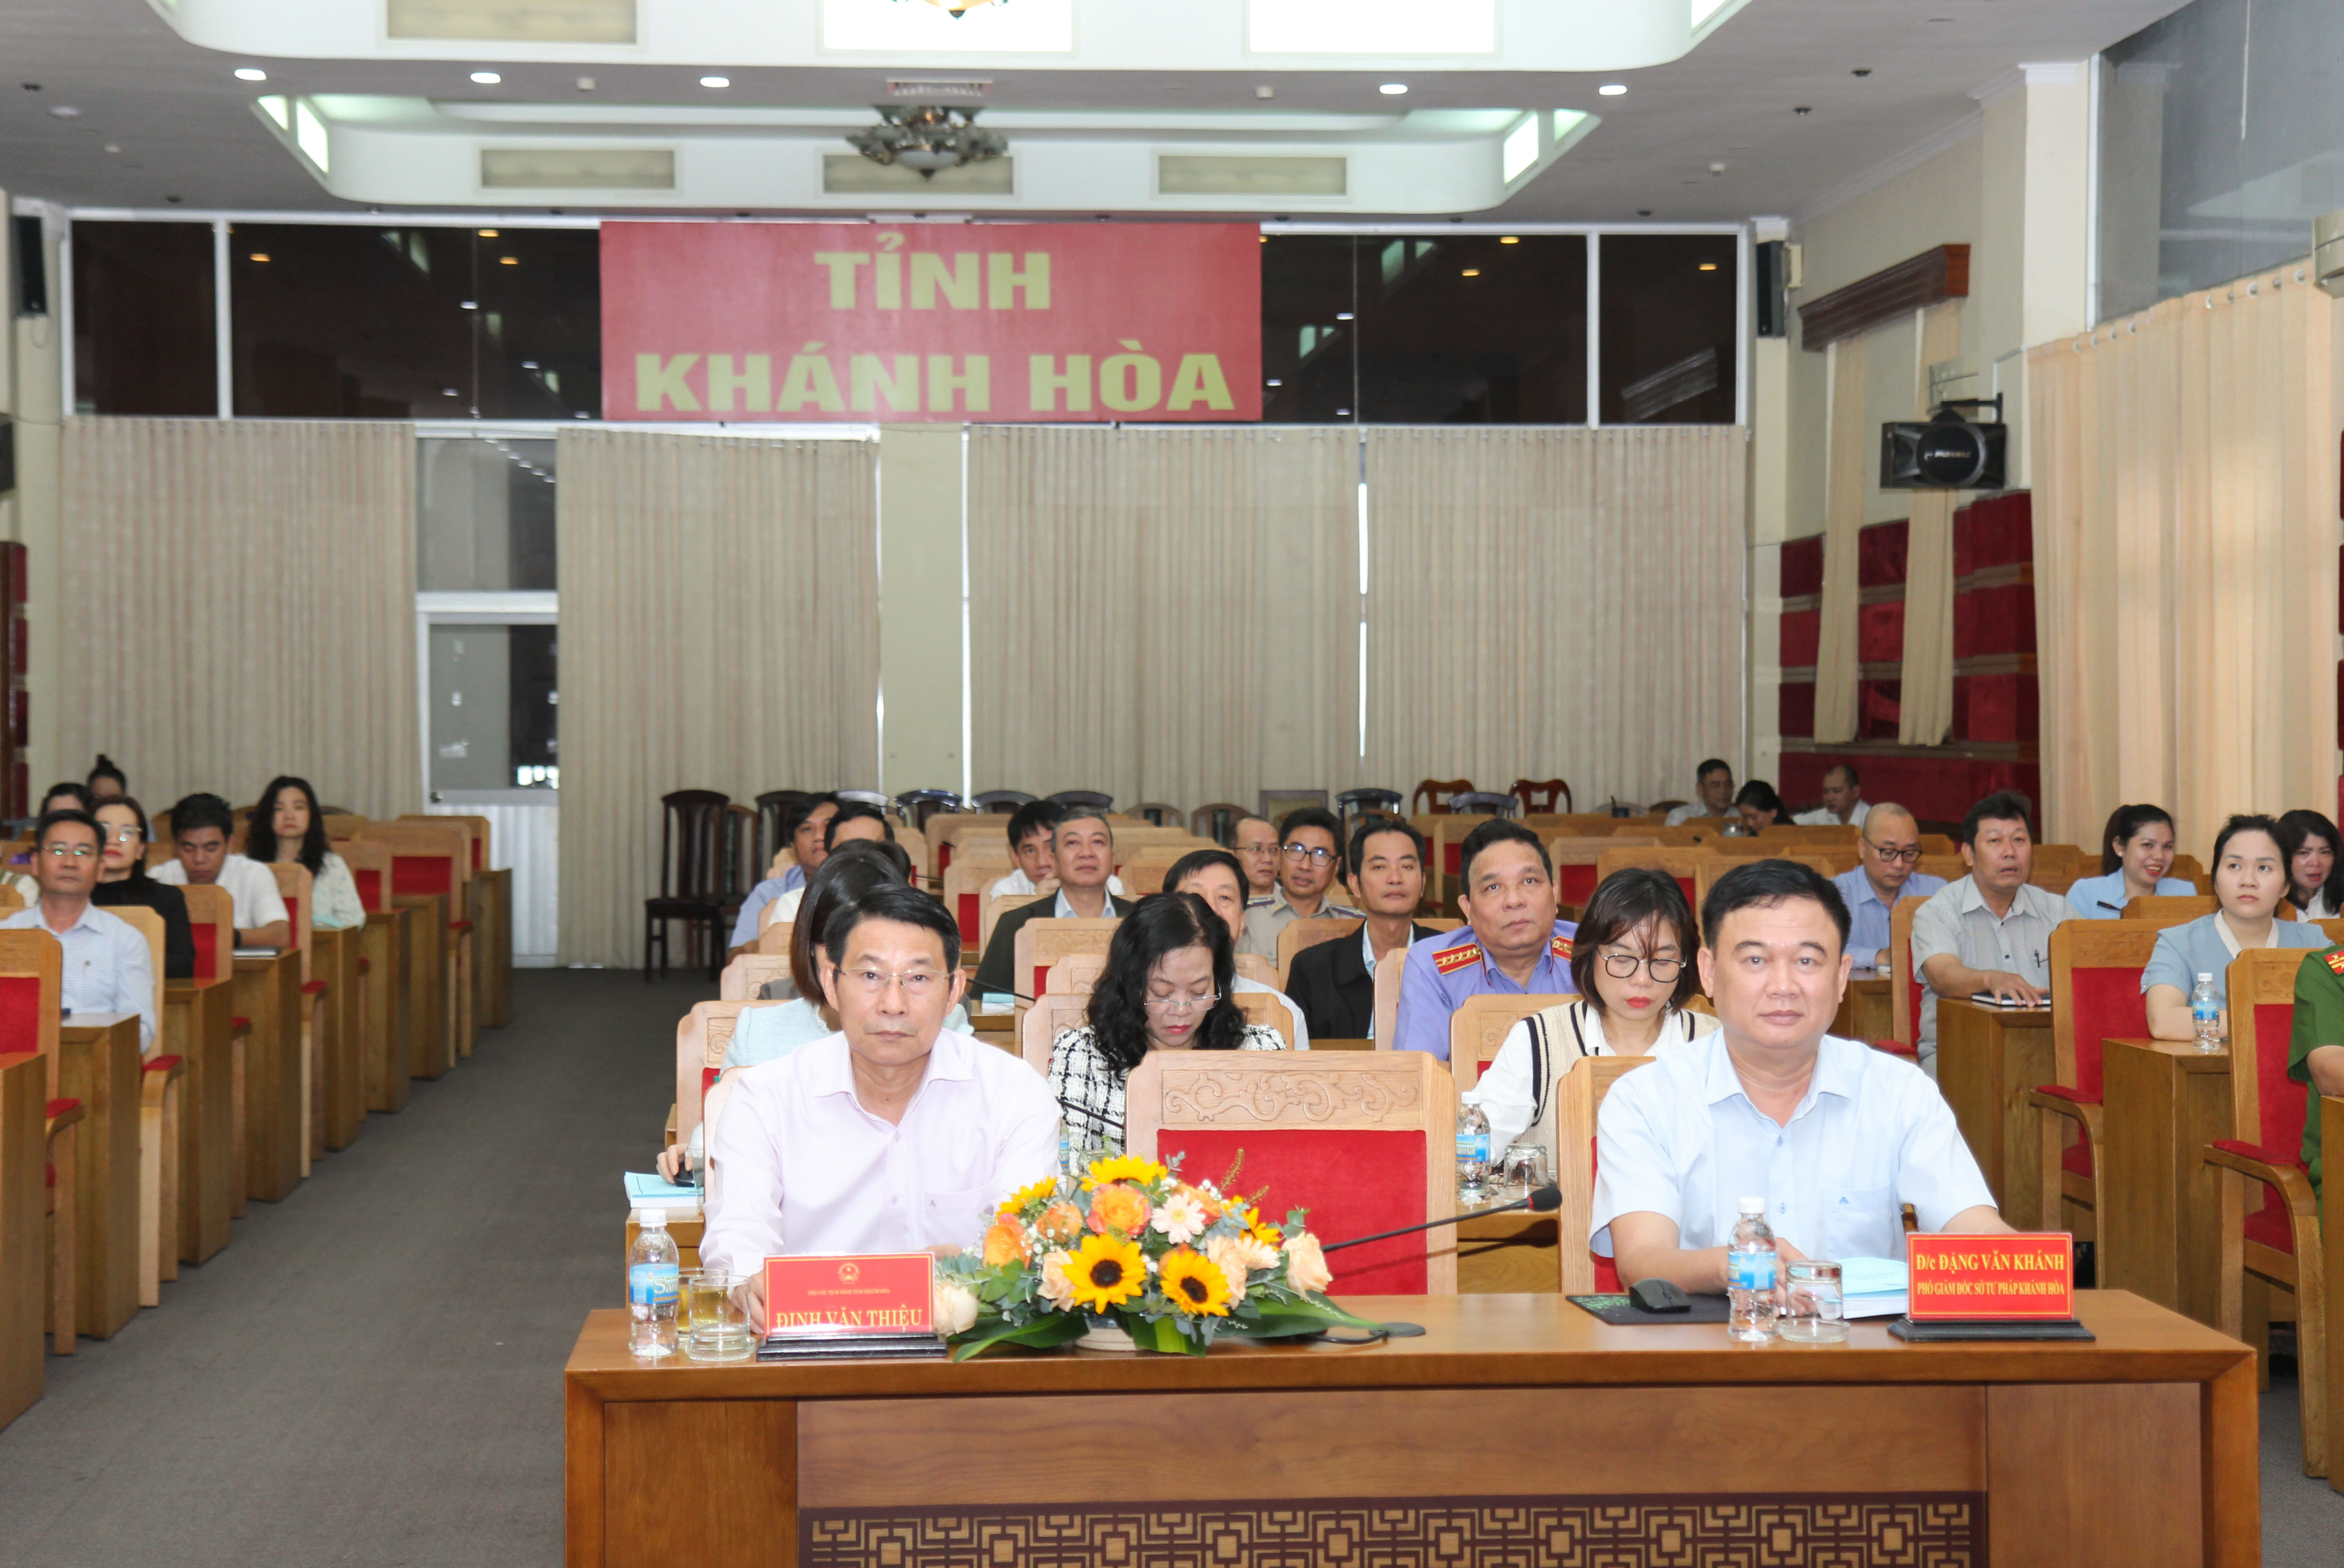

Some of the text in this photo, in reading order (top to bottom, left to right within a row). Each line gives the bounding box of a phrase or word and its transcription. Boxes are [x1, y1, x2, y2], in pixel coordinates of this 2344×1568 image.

[815, 232, 1051, 310] TỈNH
[635, 340, 1235, 412] KHÁNH HÒA
[1916, 1250, 2065, 1274] Đ/c ĐẶNG VĂN KHÁNH
[1917, 1280, 1933, 1295] PHÓ
[1934, 1280, 1956, 1295] GIÁM
[1957, 1280, 1972, 1295] ĐỐC
[1998, 1280, 2018, 1295] PHÁP
[2019, 1280, 2047, 1295] KHÁNH
[2048, 1279, 2065, 1295] HÒA
[826, 1306, 862, 1327] VĂN
[866, 1304, 922, 1333] THIỆU
